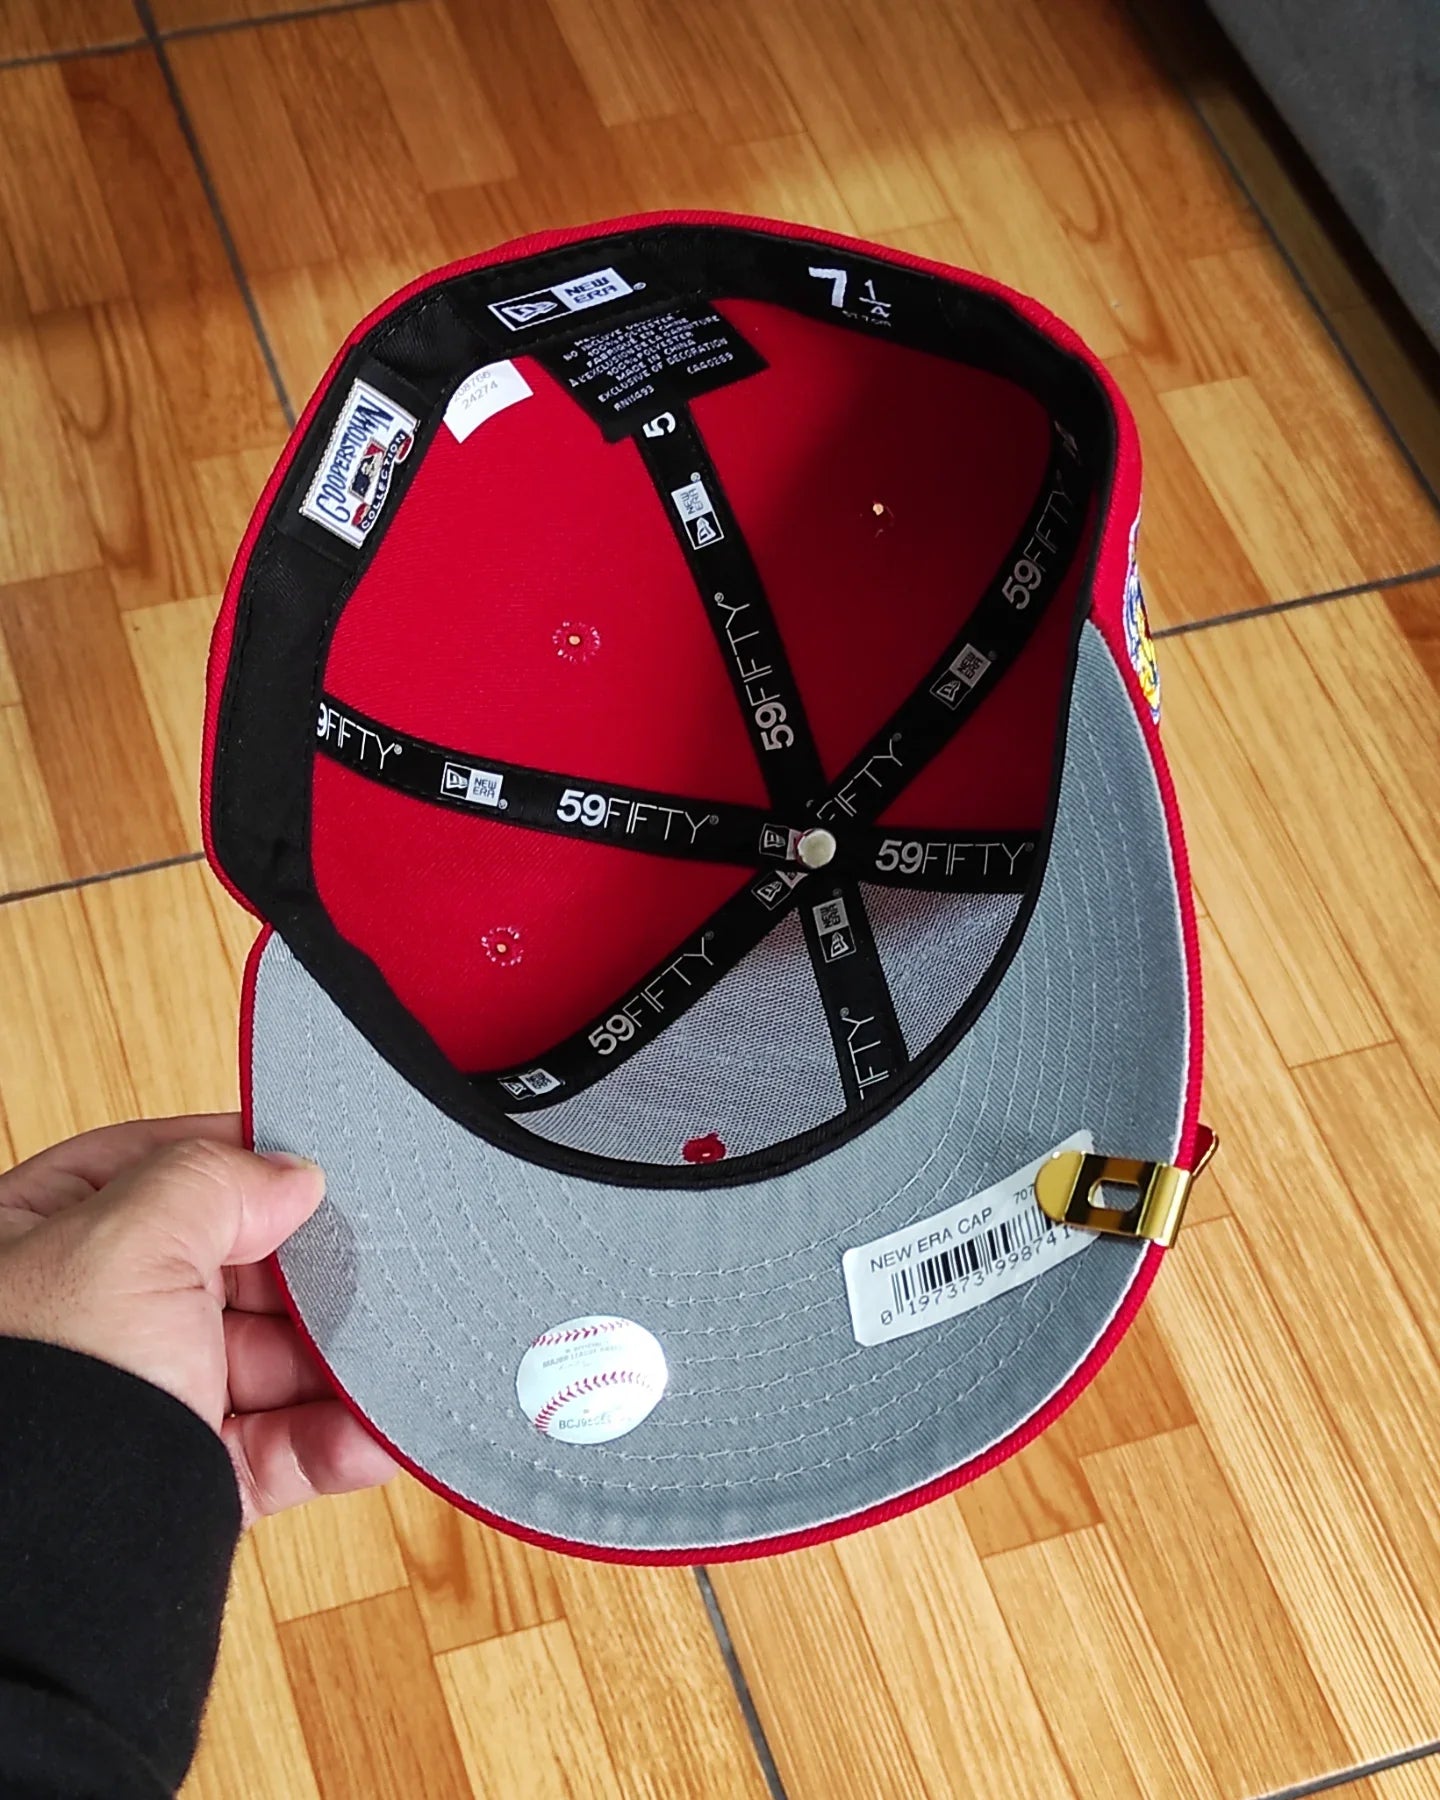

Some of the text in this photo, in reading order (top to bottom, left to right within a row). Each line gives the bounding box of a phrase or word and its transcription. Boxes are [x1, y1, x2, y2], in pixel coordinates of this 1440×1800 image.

[564, 276, 610, 296] NEW
[573, 284, 618, 304] ERA
[808, 266, 847, 308] 7
[640, 330, 655, 340] EN
[598, 337, 728, 403] EXCLUSIVE OF DECORATION
[616, 339, 697, 381] MADE IN CHINA
[316, 395, 395, 524] COOPERSTOWN
[361, 431, 407, 530] COLLECTION
[680, 492, 696, 514] NEW
[689, 488, 703, 511] ERA
[473, 786, 496, 799] ERA
[474, 777, 497, 790] NEW
[842, 1015, 890, 1100] IFTY
[870, 1206, 993, 1273] NEW ERA CAP
[880, 1309, 893, 1326] 0
[907, 1272, 985, 1316] 197373
